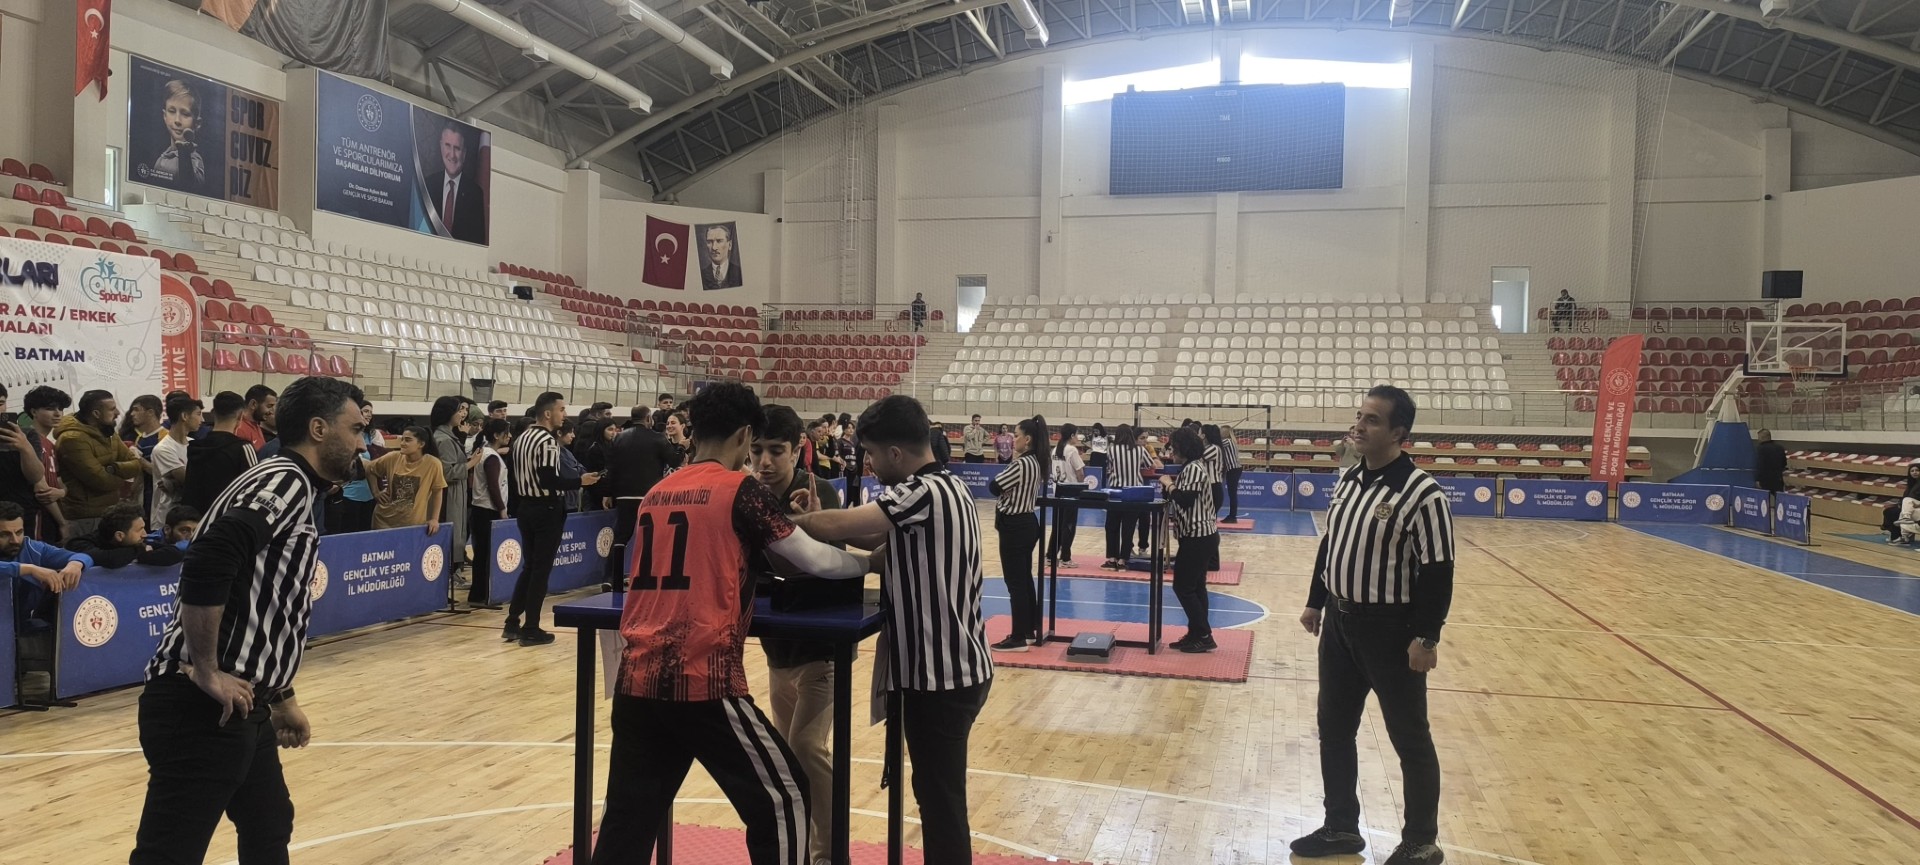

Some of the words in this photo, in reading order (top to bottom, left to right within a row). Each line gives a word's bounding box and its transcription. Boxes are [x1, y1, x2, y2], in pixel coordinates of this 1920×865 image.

[231, 94, 265, 131] SPOR
[341, 137, 358, 149] TÜM
[359, 143, 396, 162] ANTRENÖR
[333, 145, 342, 156] VE
[343, 148, 404, 174] SPORCULARIMIZA
[335, 158, 369, 174] BAŞARILAR
[369, 167, 401, 183] DİLİYORUM
[0, 257, 59, 291] LARI
[82, 268, 142, 302] OKUL
[99, 290, 135, 303] Sporları
[15, 304, 27, 317] A
[31, 305, 56, 319] KIZ
[70, 308, 117, 323] ERKEK
[15, 347, 85, 362] BATMAN
[1607, 401, 1615, 411] VE
[1603, 412, 1614, 443] GENÇLİK
[1613, 402, 1626, 447] MÜDÜRLÜĞÜ
[1600, 445, 1610, 475] BATMAN
[1610, 458, 1619, 476] SPOR
[362, 550, 394, 563] BATMAN
[562, 543, 570, 553] VE
[570, 541, 586, 552] SPOR
[630, 511, 691, 591] 11
[343, 566, 377, 581] GENÇLİK
[379, 565, 390, 575] VE
[390, 562, 411, 574] SPOR
[160, 582, 179, 596] BAT
[348, 583, 356, 596] İL
[357, 576, 405, 594] MÜDÜRLÜĞÜ
[138, 602, 174, 619] GENÇL
[148, 621, 161, 637] İL
